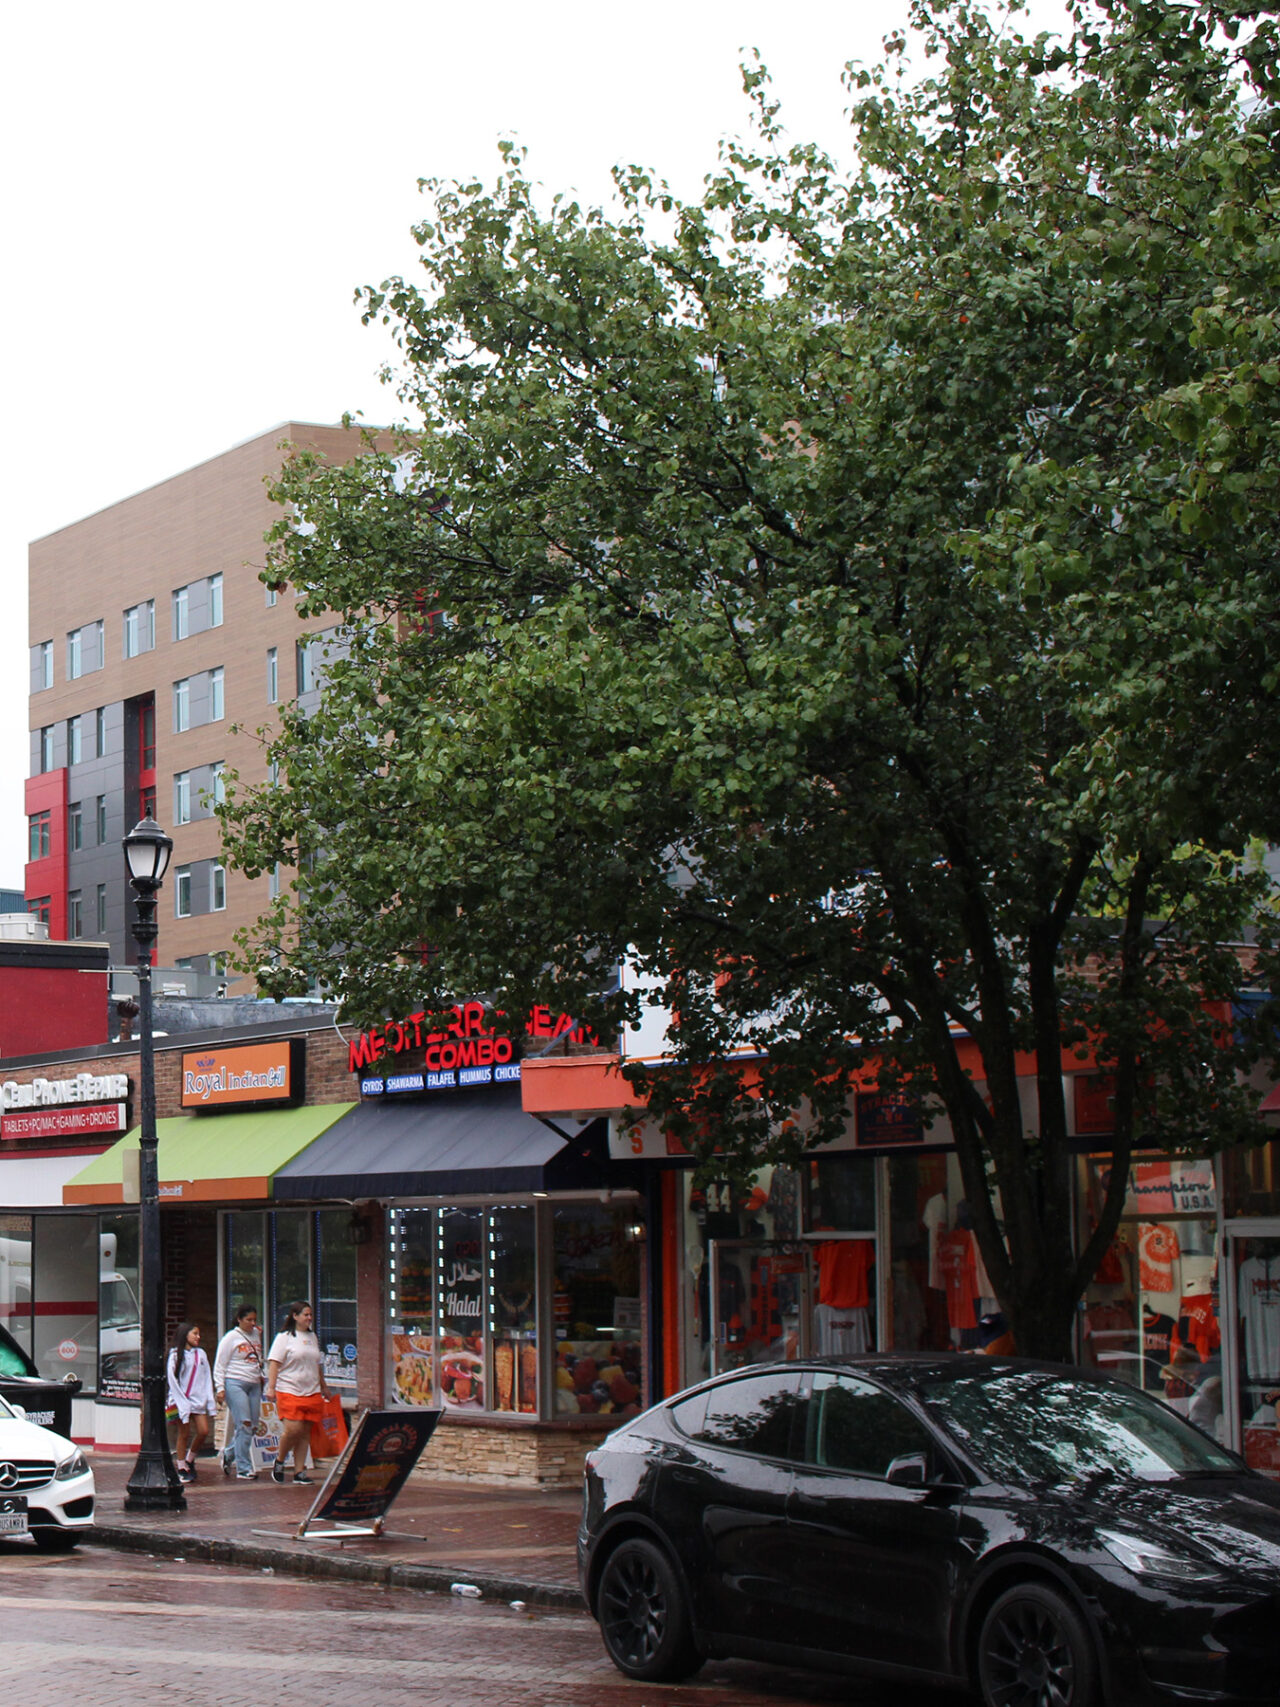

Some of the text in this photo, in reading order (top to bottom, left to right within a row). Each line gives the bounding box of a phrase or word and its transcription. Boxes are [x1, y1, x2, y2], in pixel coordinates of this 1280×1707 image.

[425, 1037, 513, 1071] COMBO
[32, 1078, 78, 1106] PHONE
[77, 1073, 129, 1101] REPAIR
[184, 1066, 226, 1100] Royal
[228, 1071, 268, 1090] Indian
[362, 1064, 520, 1093] GYROS SHAWARMA FALAFEL HUMMUS CHICKE
[1125, 1170, 1211, 1208] hampion
[446, 1292, 482, 1317] Halal
